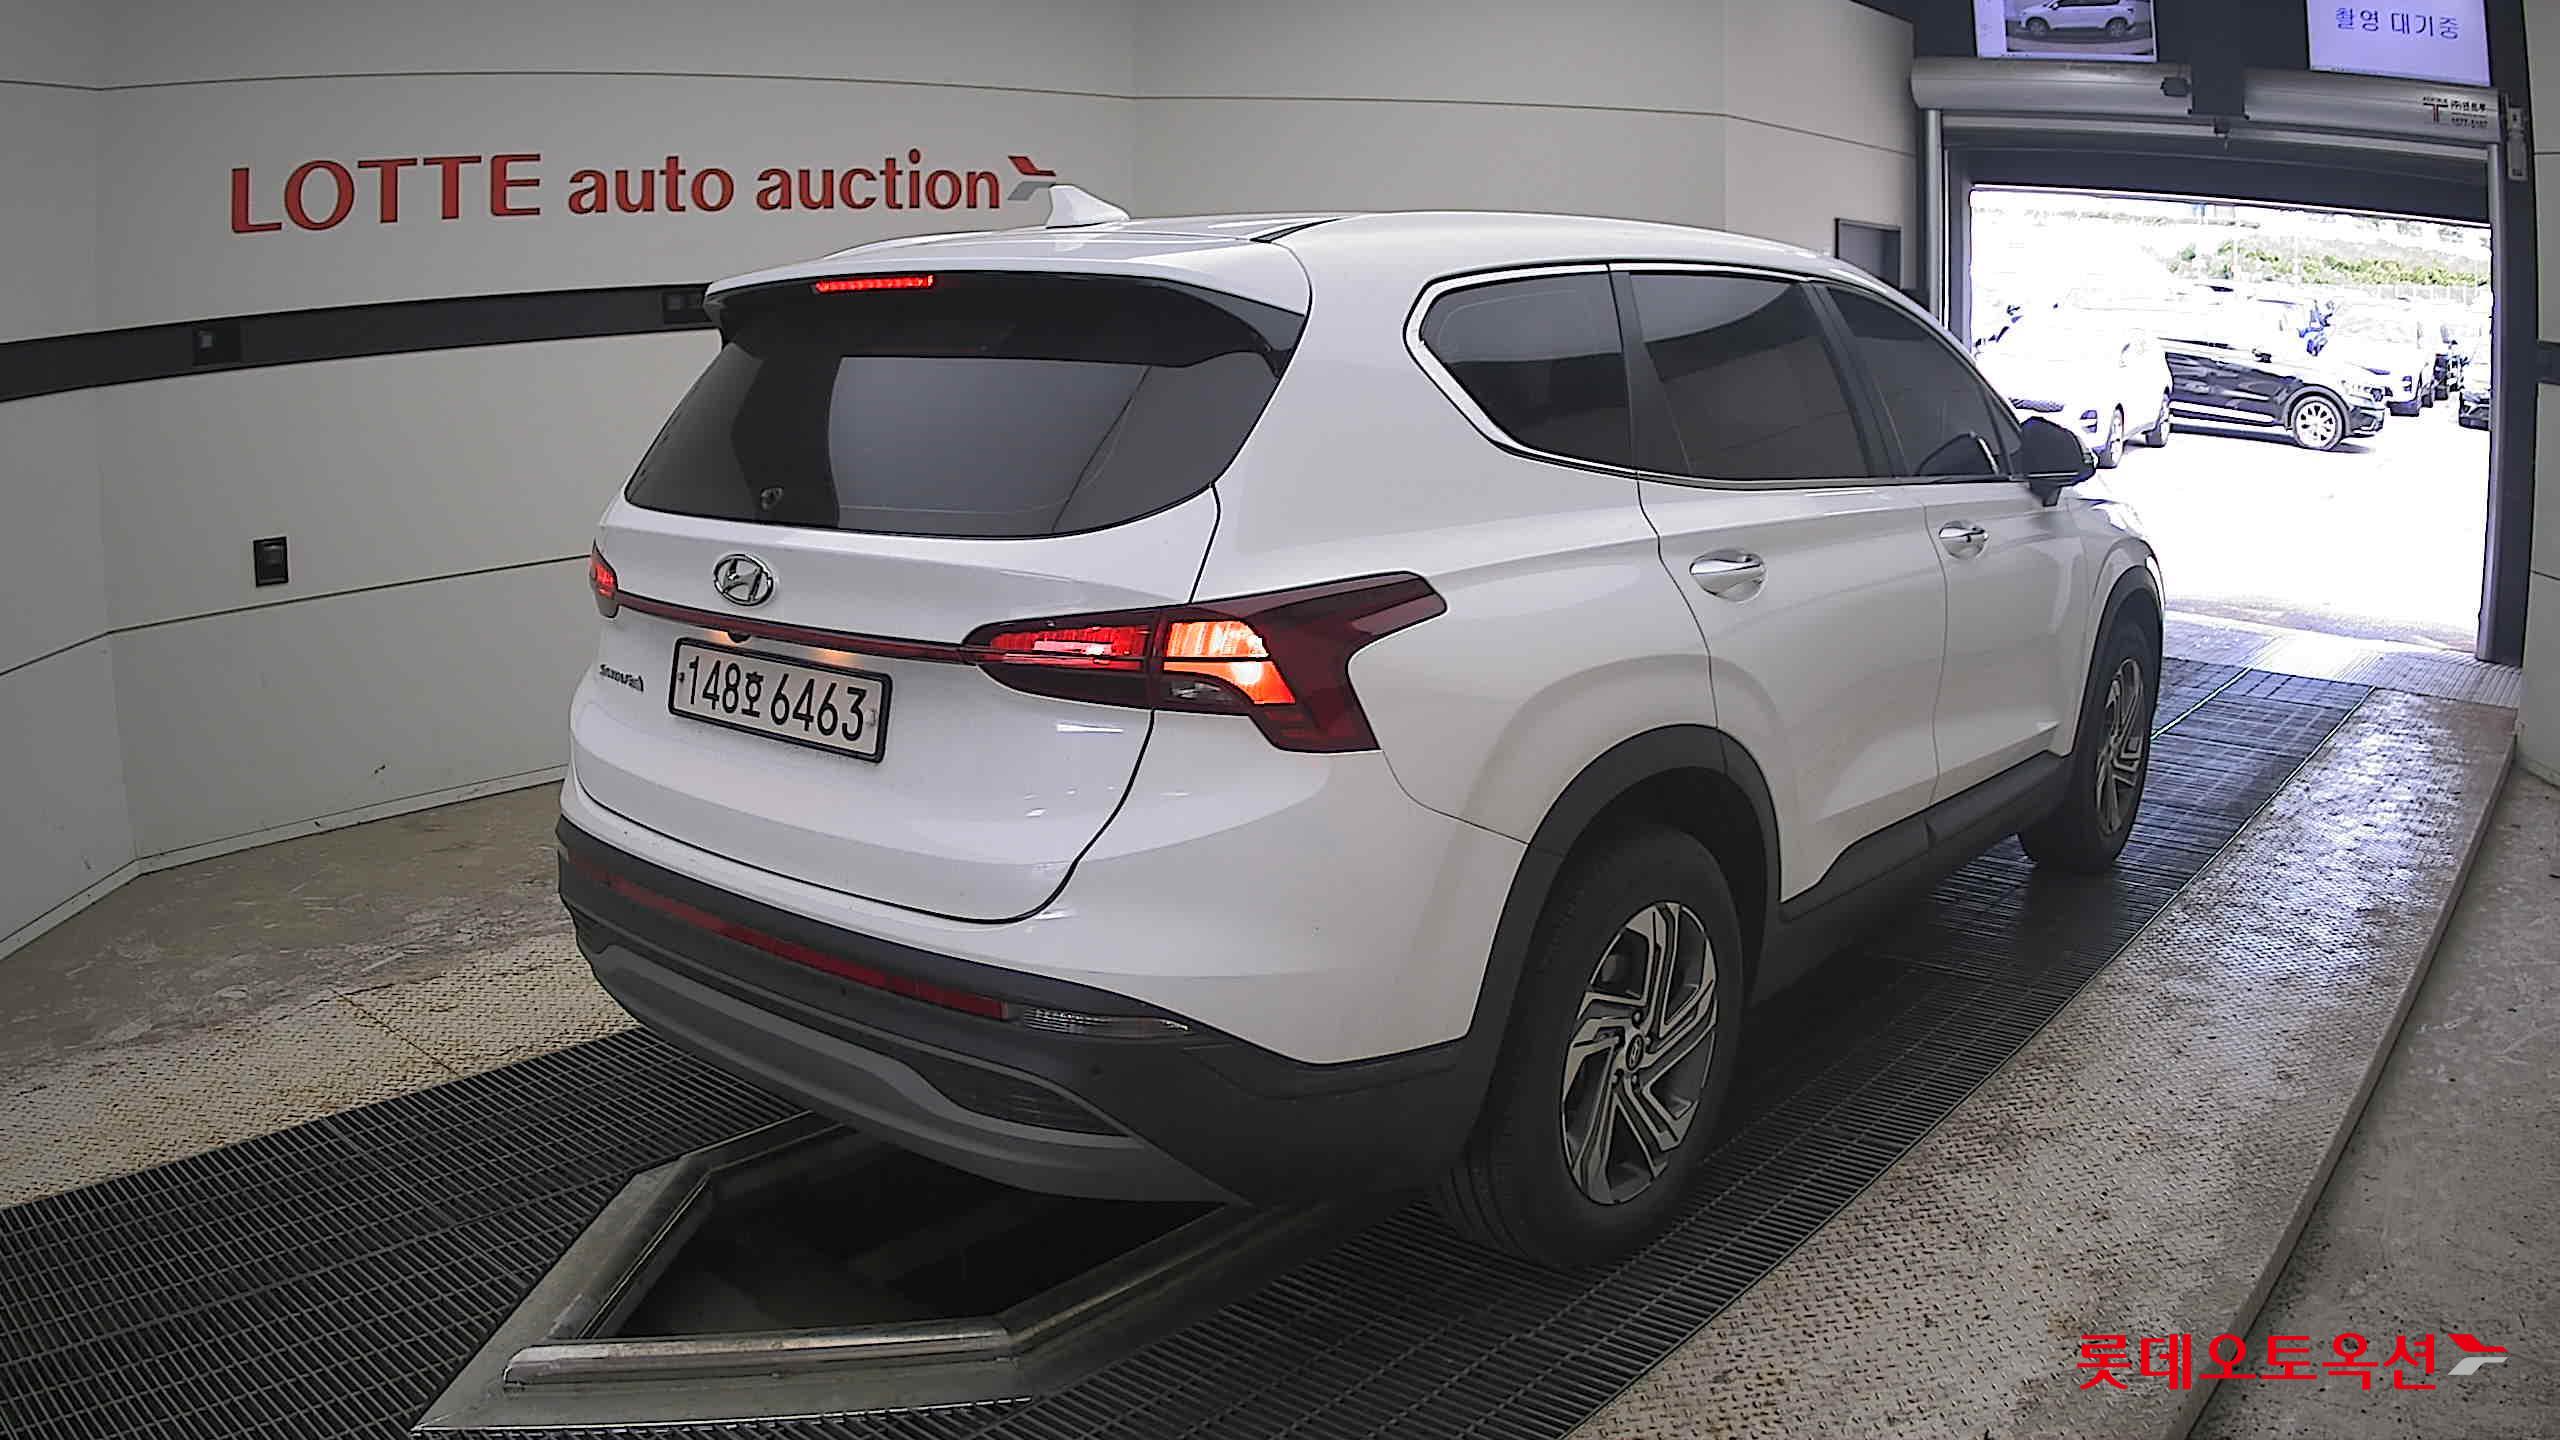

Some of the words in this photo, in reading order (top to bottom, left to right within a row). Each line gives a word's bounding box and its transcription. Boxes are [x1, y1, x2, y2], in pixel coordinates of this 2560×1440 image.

[2335, 7, 2380, 33] 촬영
[2391, 13, 2460, 40] 대기중
[231, 154, 542, 234] LOTTE
[568, 156, 735, 214] auto
[755, 149, 1001, 211] auction
[770, 673, 867, 741] 6463
